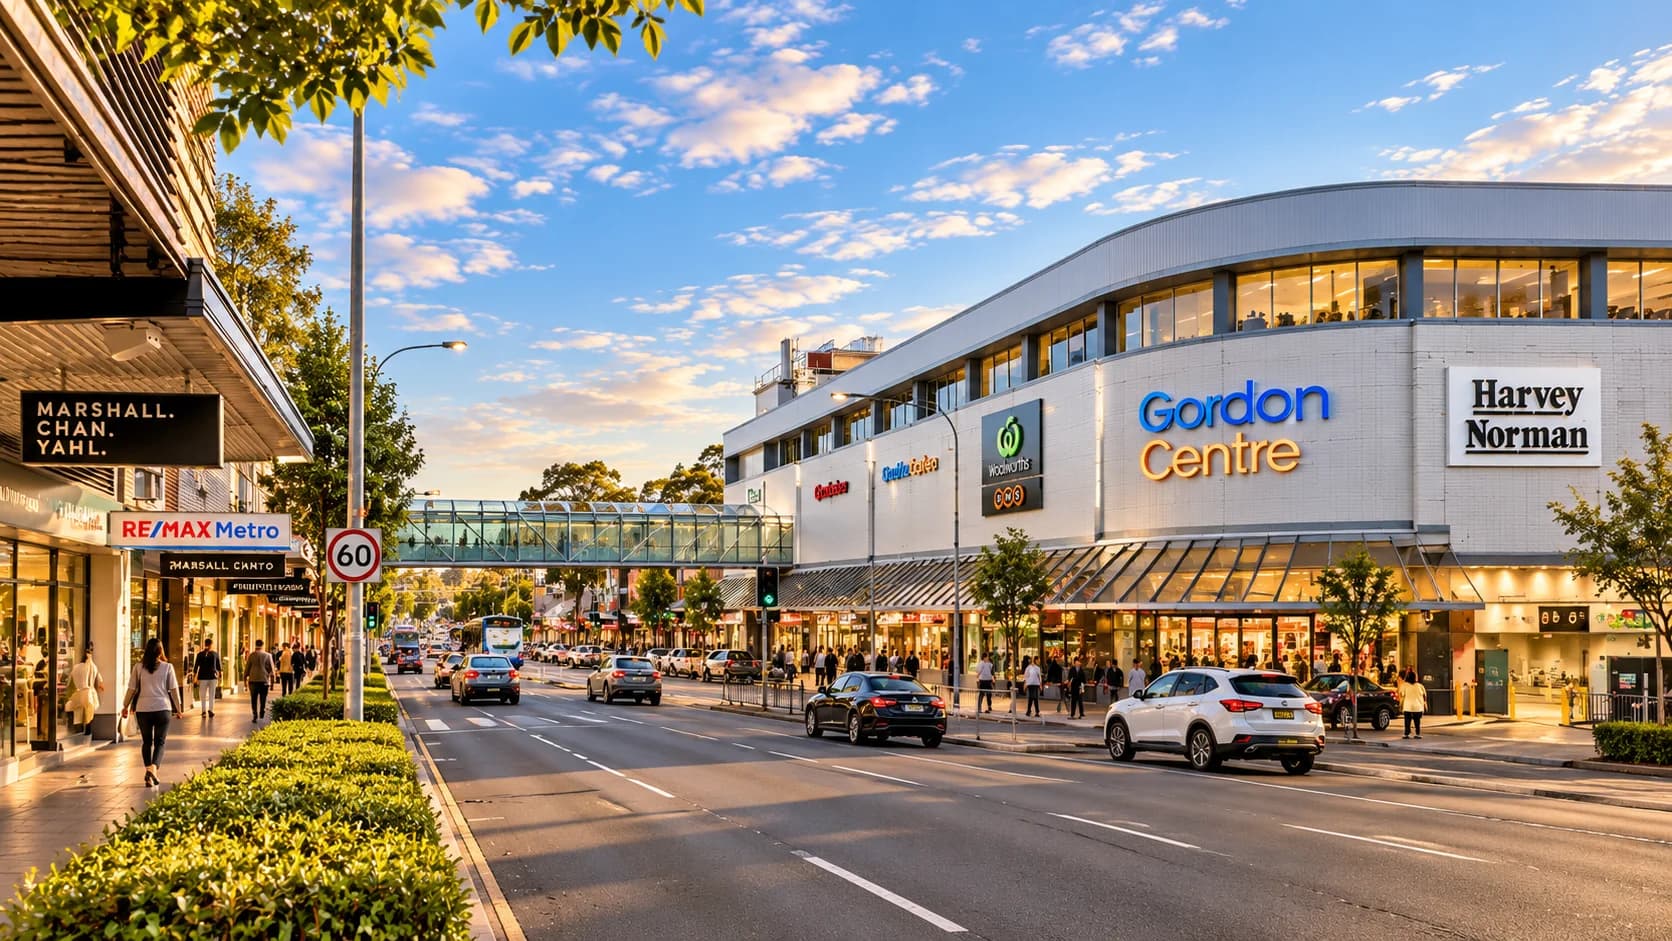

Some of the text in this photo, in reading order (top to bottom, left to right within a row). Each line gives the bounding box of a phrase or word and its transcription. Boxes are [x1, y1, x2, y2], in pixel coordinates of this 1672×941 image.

[37, 401, 174, 419] MARSHALL.
[1138, 379, 1331, 433] Gordon
[1472, 379, 1583, 416] Harvey
[37, 420, 114, 437] CHAN.
[1465, 419, 1589, 449] Norman
[36, 439, 107, 456] YAHL.
[1139, 432, 1301, 482] Centre
[121, 519, 280, 539] RE/MAX Metro
[336, 543, 372, 568] 60
